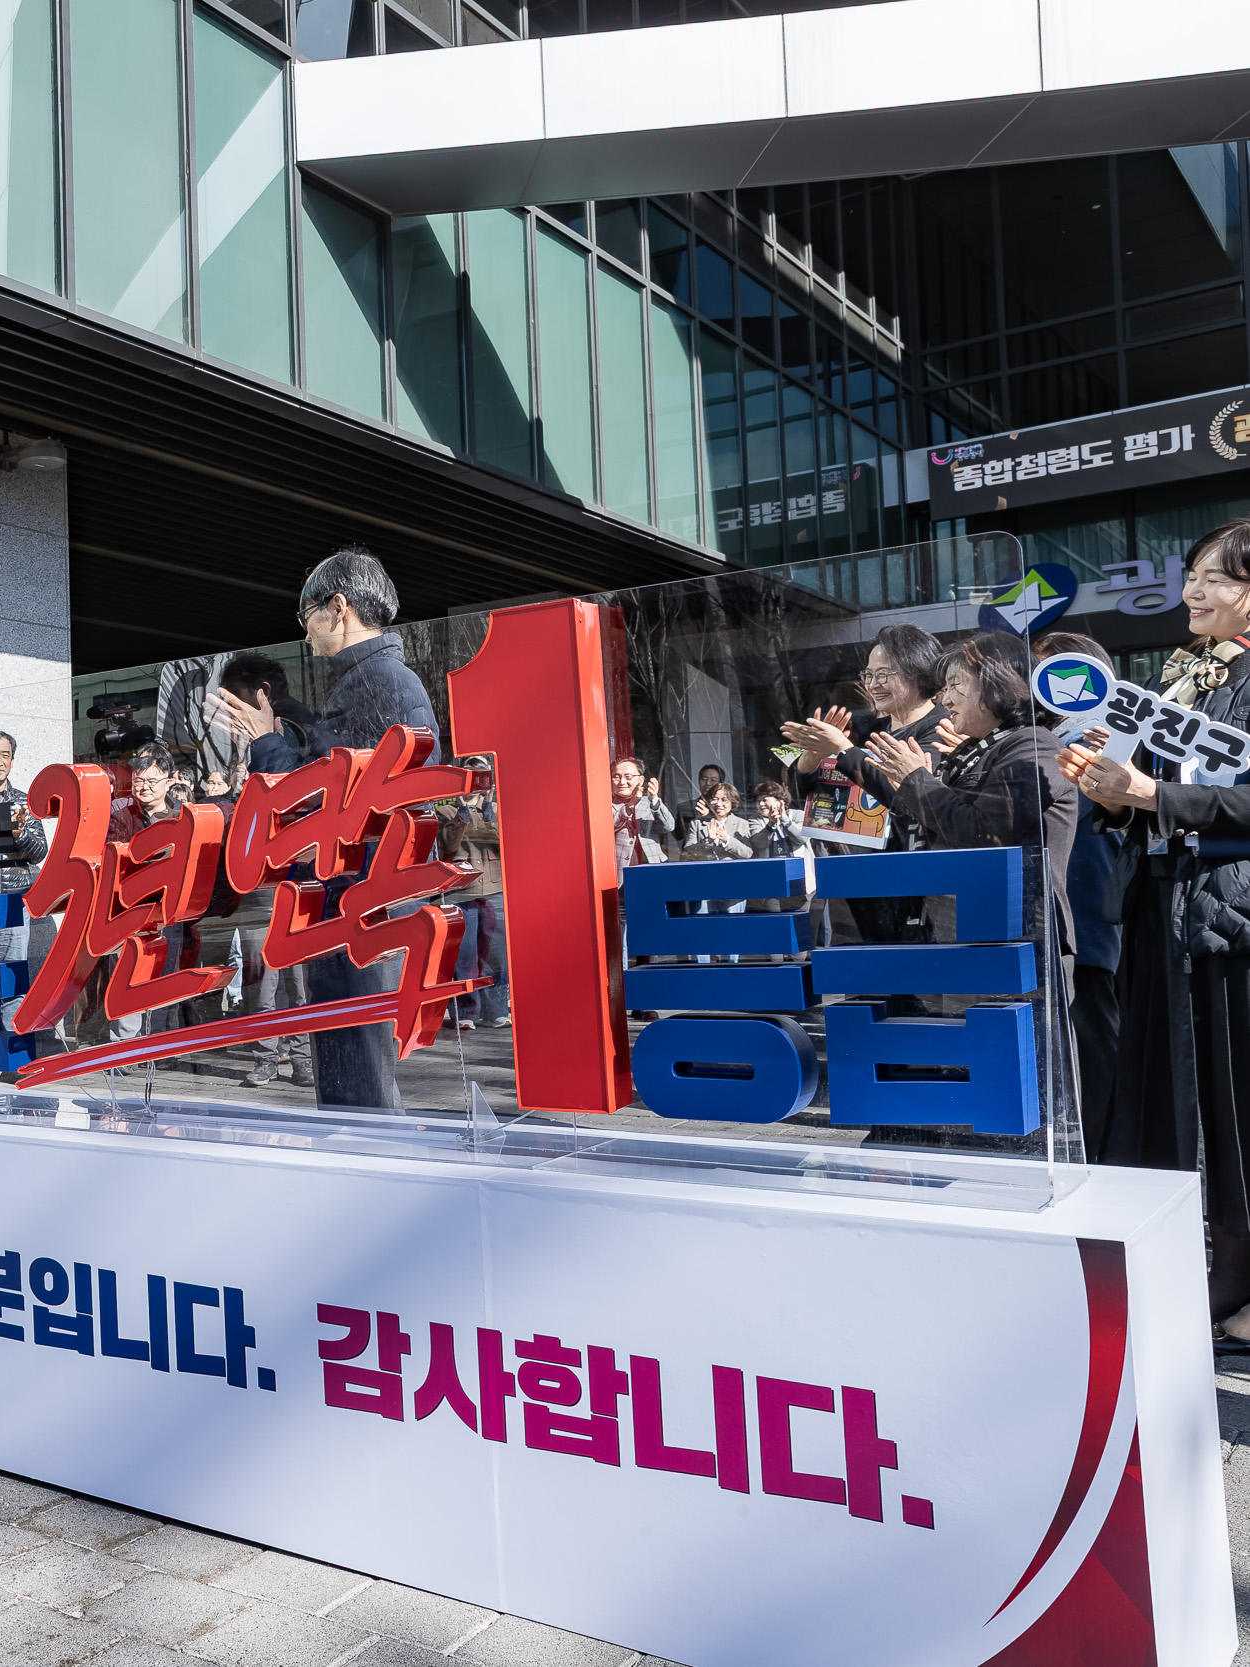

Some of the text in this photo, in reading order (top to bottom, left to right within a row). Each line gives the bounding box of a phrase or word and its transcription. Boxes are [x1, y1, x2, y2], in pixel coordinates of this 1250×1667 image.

[953, 439, 1113, 492] 종합청렴도
[1123, 425, 1196, 458] 평가
[1105, 687, 1246, 772] 광진구
[316, 1302, 935, 1530] 감사합니다.
